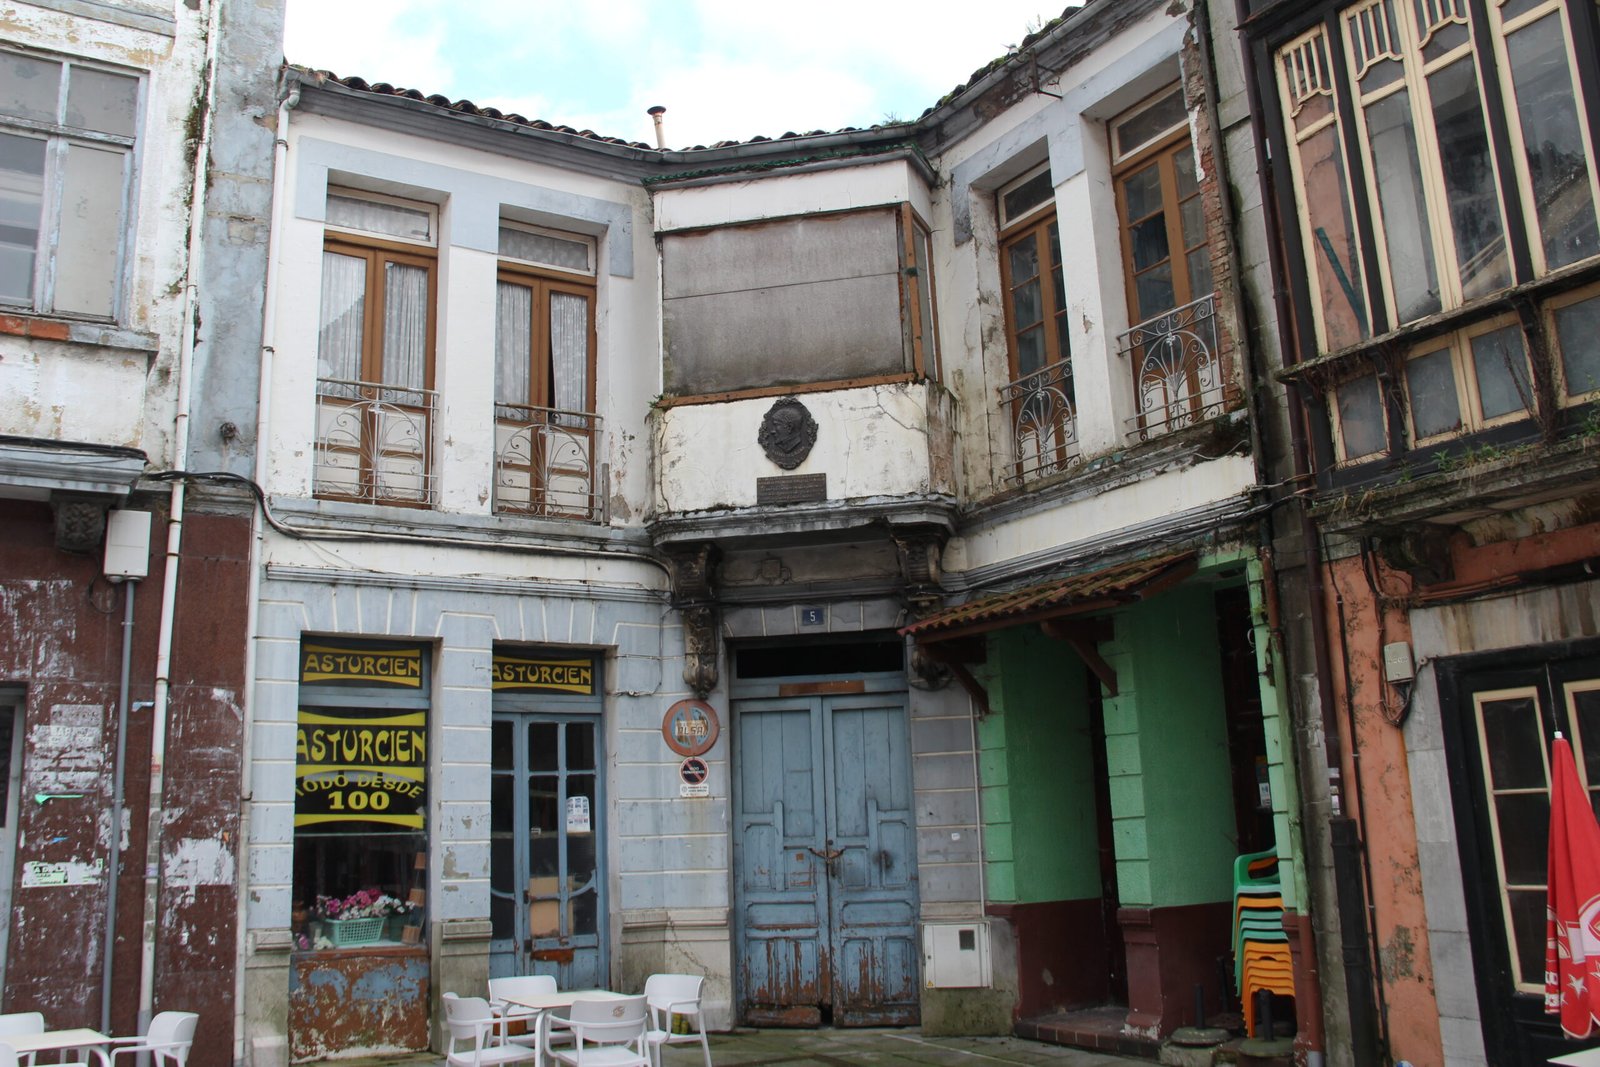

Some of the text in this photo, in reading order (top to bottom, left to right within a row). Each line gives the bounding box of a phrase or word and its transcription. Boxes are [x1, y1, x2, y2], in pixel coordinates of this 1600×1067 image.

[810, 610, 816, 622] 5
[304, 653, 420, 676] ASTURCIEN
[493, 663, 591, 685] ASTURCIEN
[296, 728, 426, 764] ASTURCIEN
[357, 774, 425, 799] DESDE
[328, 790, 390, 810] 100
